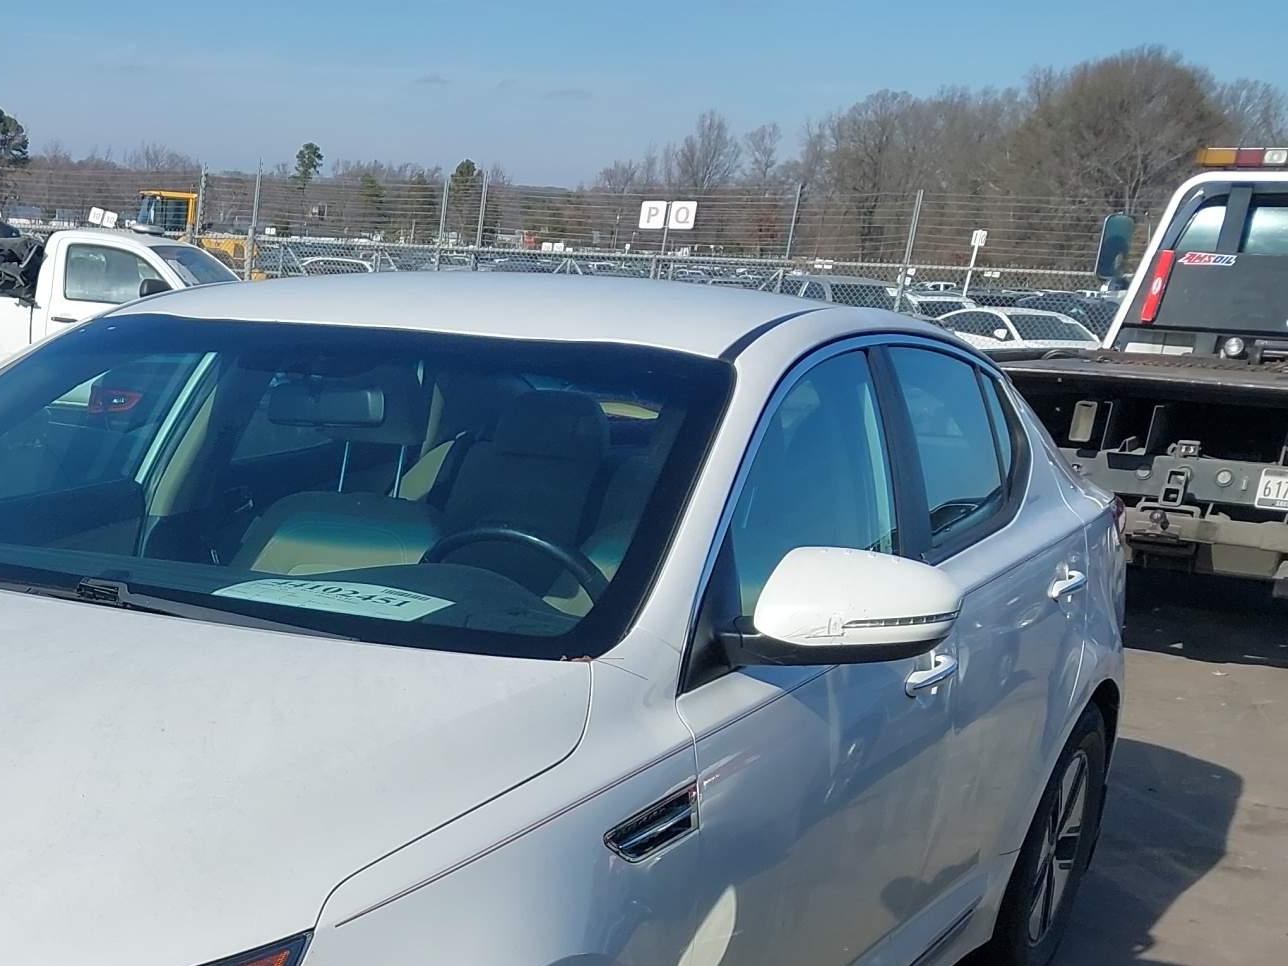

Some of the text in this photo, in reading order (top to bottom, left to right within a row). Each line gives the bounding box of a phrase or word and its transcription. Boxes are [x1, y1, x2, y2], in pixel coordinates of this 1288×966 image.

[646, 206, 690, 224] P Q
[1182, 252, 1236, 265] AMSOIL
[272, 580, 411, 607] 44102451
